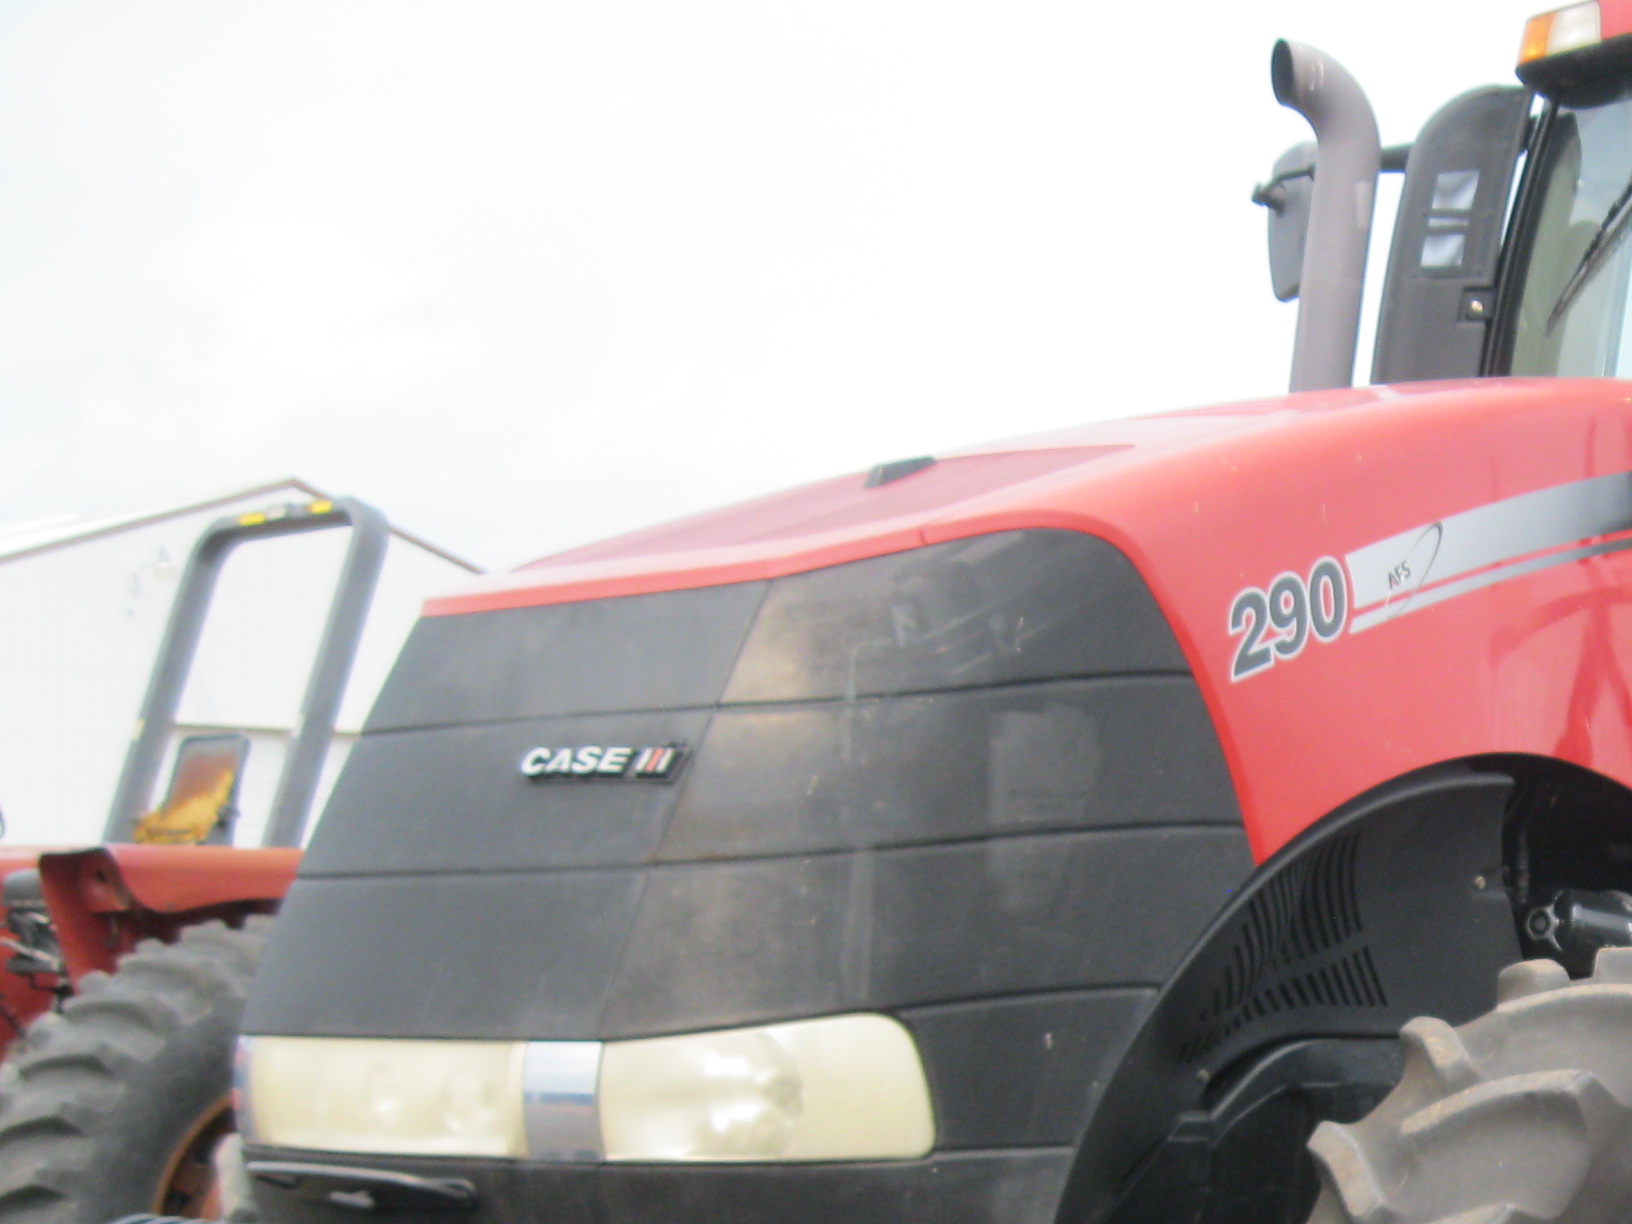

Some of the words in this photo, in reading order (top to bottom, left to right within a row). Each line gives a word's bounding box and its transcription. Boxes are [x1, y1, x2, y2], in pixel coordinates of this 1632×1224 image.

[1386, 559, 1412, 592] AFS
[1228, 555, 1348, 684] 290
[520, 745, 633, 777] CASE
